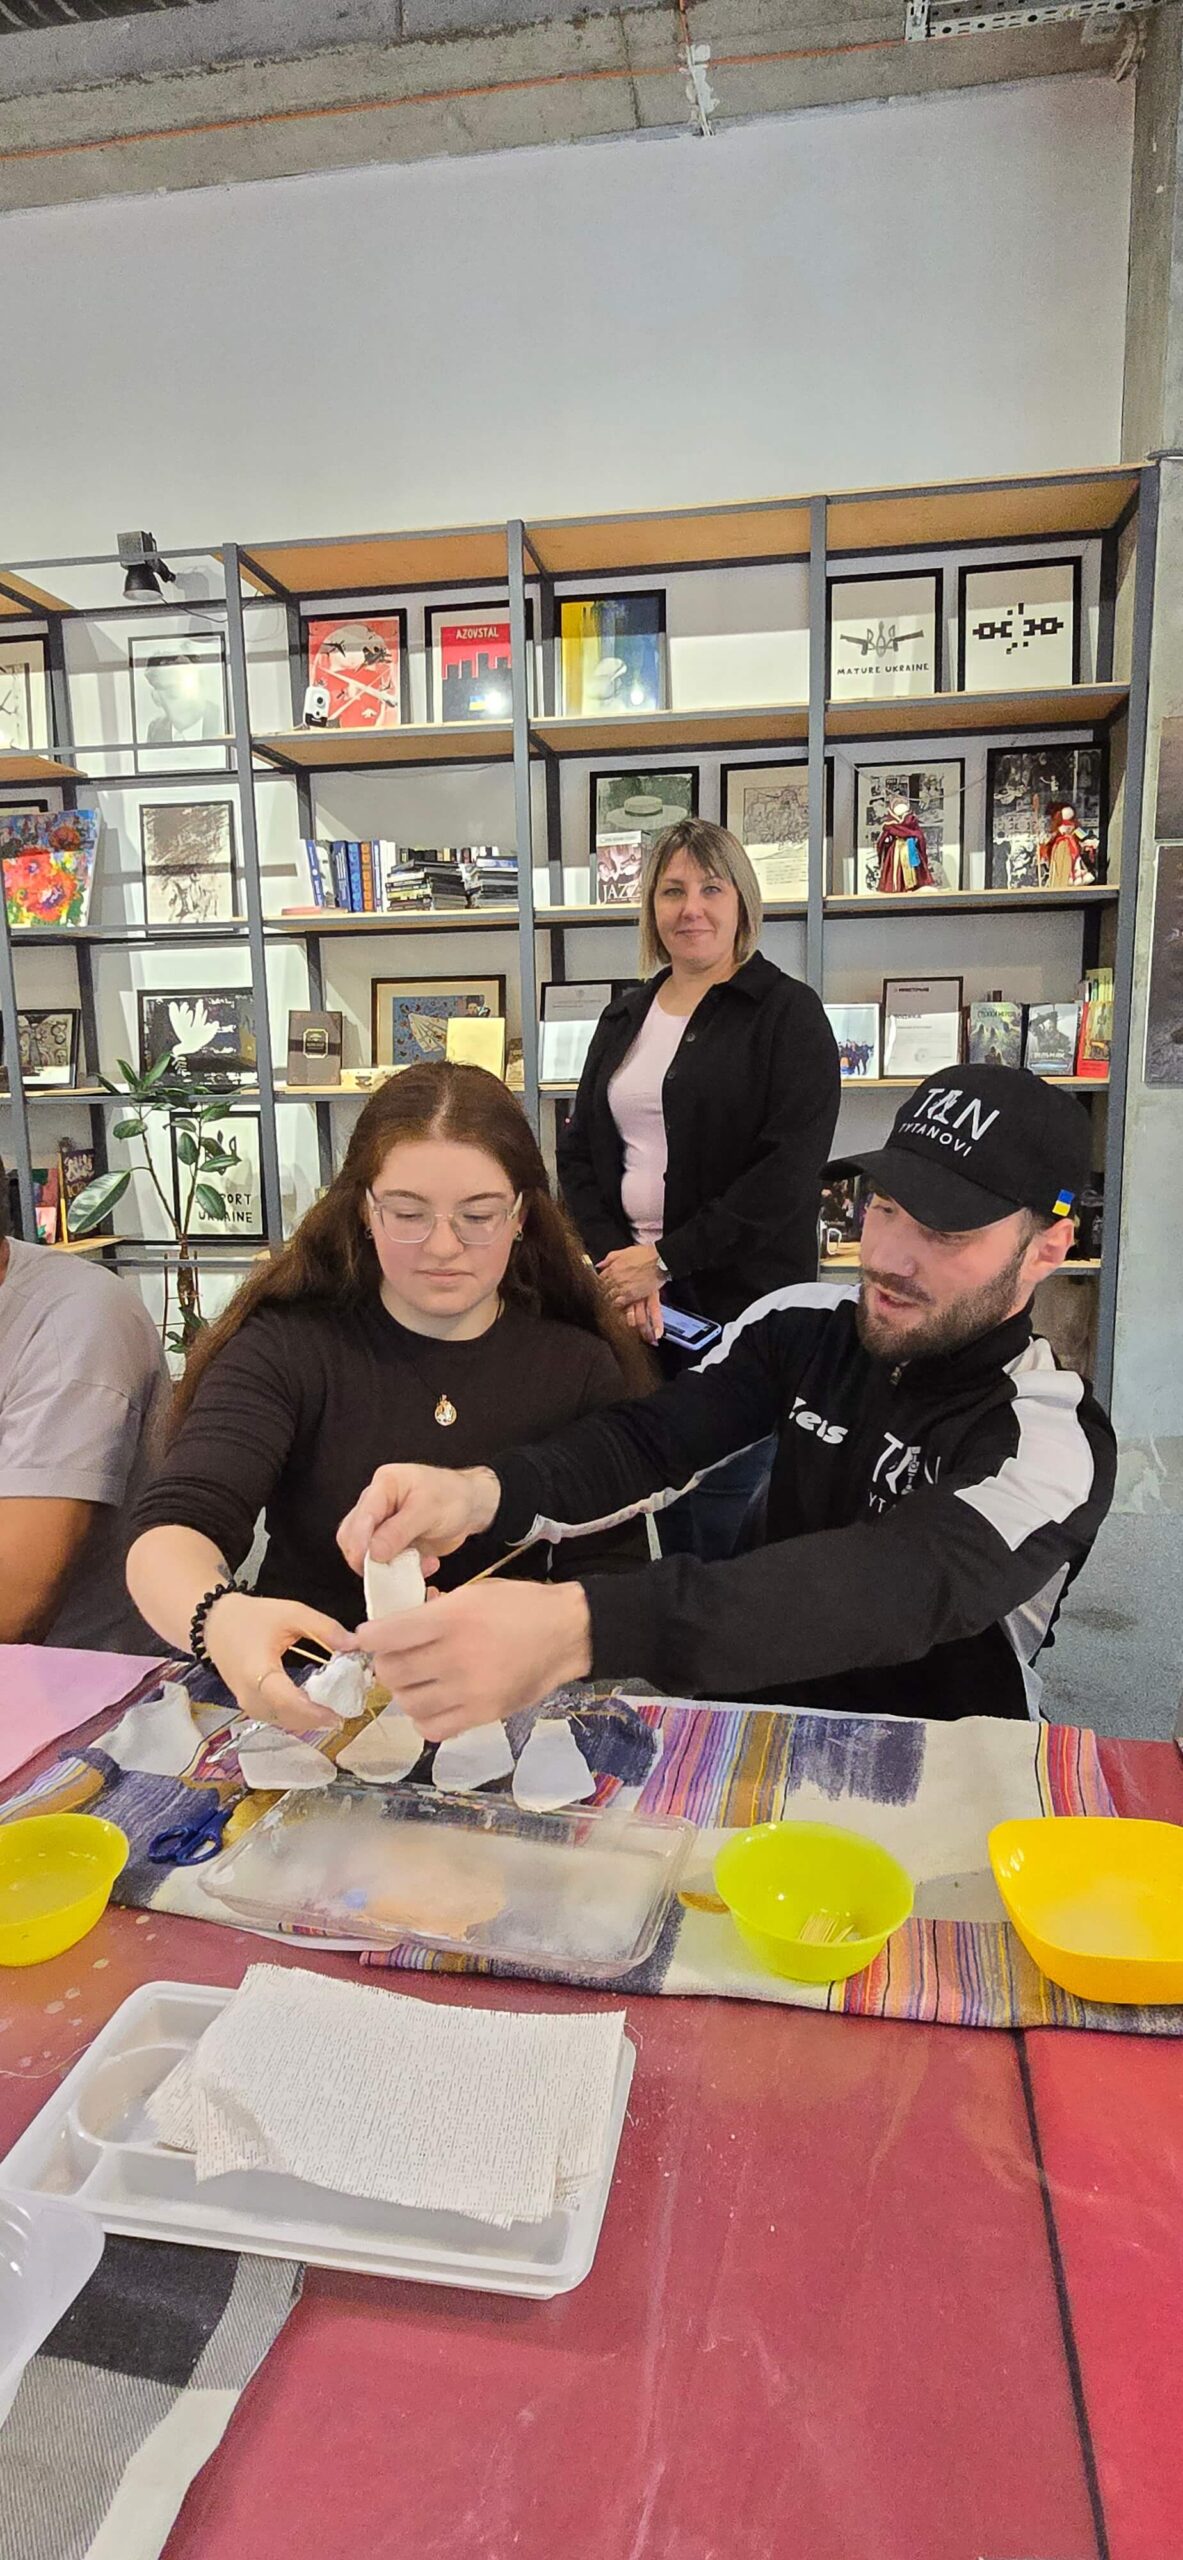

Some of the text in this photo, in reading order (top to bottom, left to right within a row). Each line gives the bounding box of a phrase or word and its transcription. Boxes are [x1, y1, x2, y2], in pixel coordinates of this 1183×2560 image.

[456, 627, 499, 639] AZOVSTAL
[837, 663, 929, 675] MATURE UKRAINE
[601, 883, 640, 904] JAZZ
[898, 1123, 972, 1157] TYTANOVI
